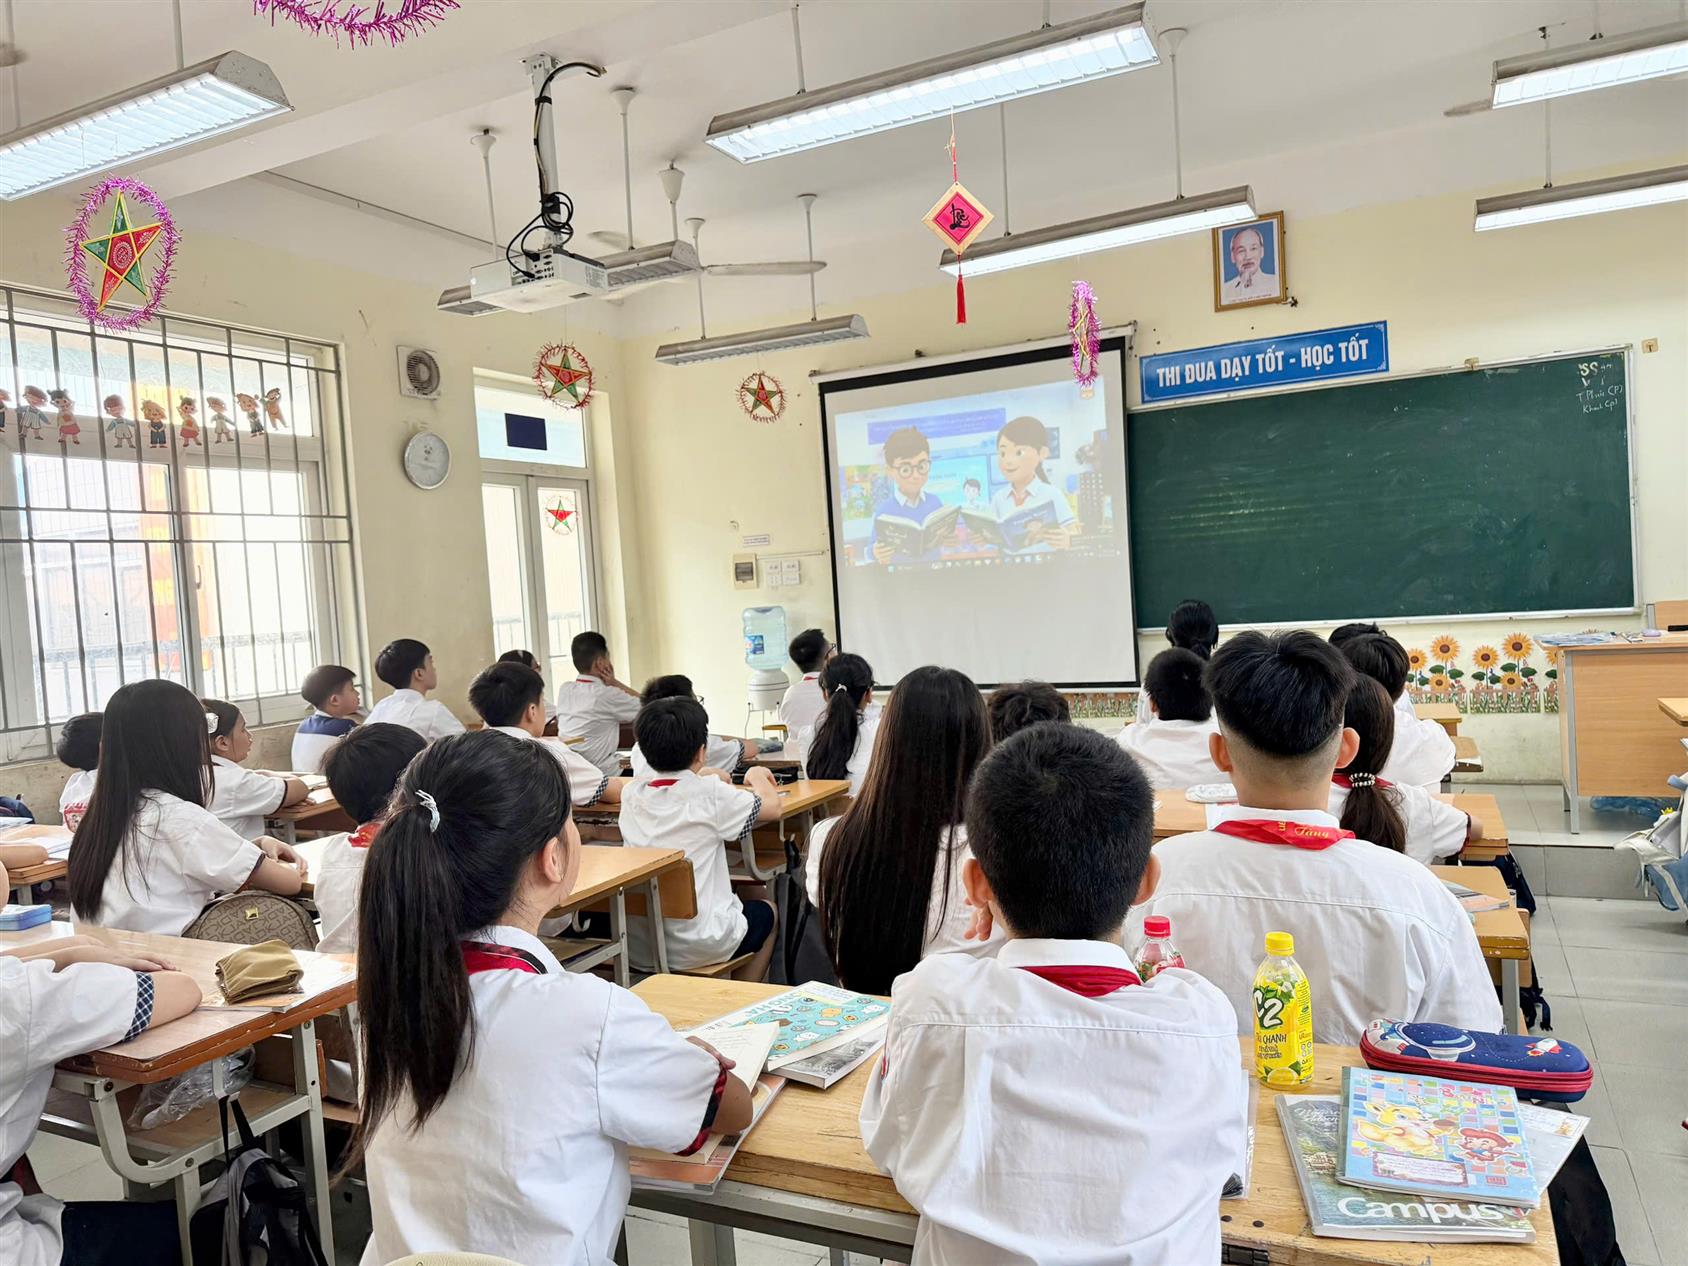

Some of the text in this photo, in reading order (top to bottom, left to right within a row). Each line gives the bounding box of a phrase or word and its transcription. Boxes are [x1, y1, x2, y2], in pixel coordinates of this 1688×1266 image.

[1156, 366, 1181, 388] THI
[1184, 360, 1217, 384] ĐUA
[1220, 355, 1251, 381] DẠY
[1255, 345, 1285, 374] TỐT
[1300, 344, 1334, 371] HỌC
[1338, 332, 1369, 362] TỐT
[1337, 1196, 1505, 1224] Campus
